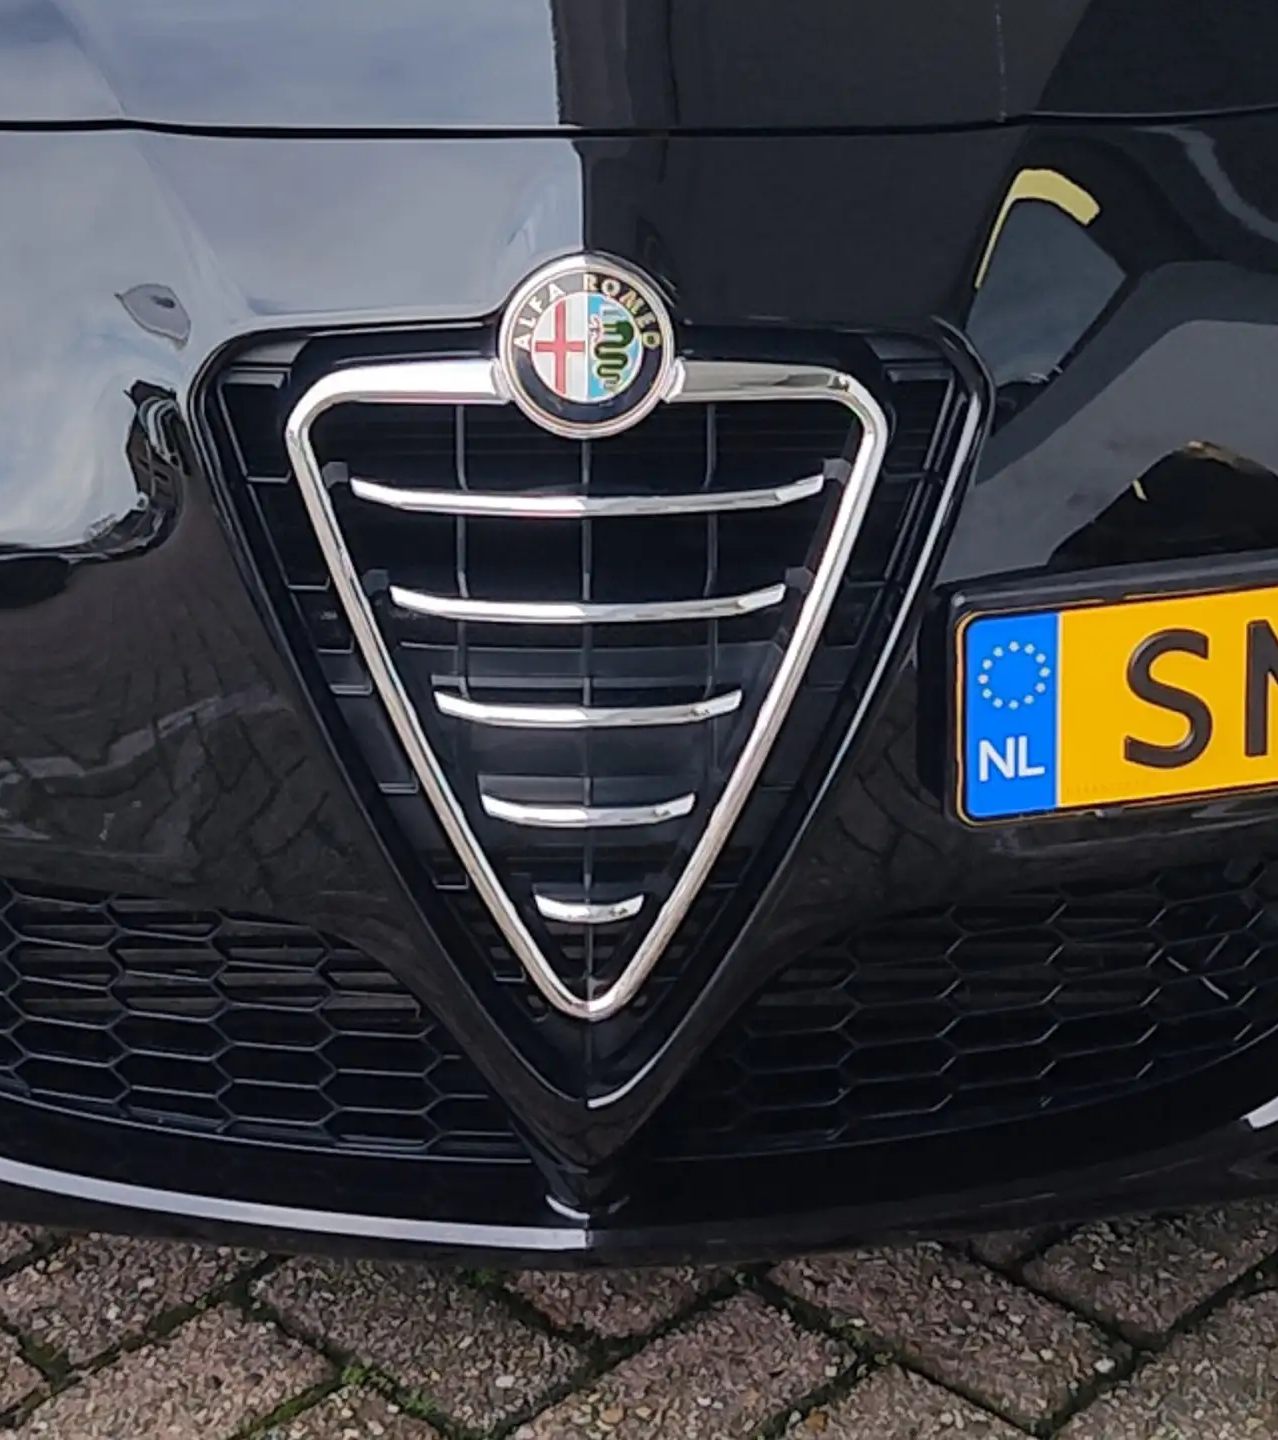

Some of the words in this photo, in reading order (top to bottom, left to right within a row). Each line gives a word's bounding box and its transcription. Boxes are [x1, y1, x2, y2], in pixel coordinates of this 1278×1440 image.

[513, 282, 565, 353] ALFA
[583, 273, 661, 349] ROMEO
[979, 735, 1046, 782] NL
